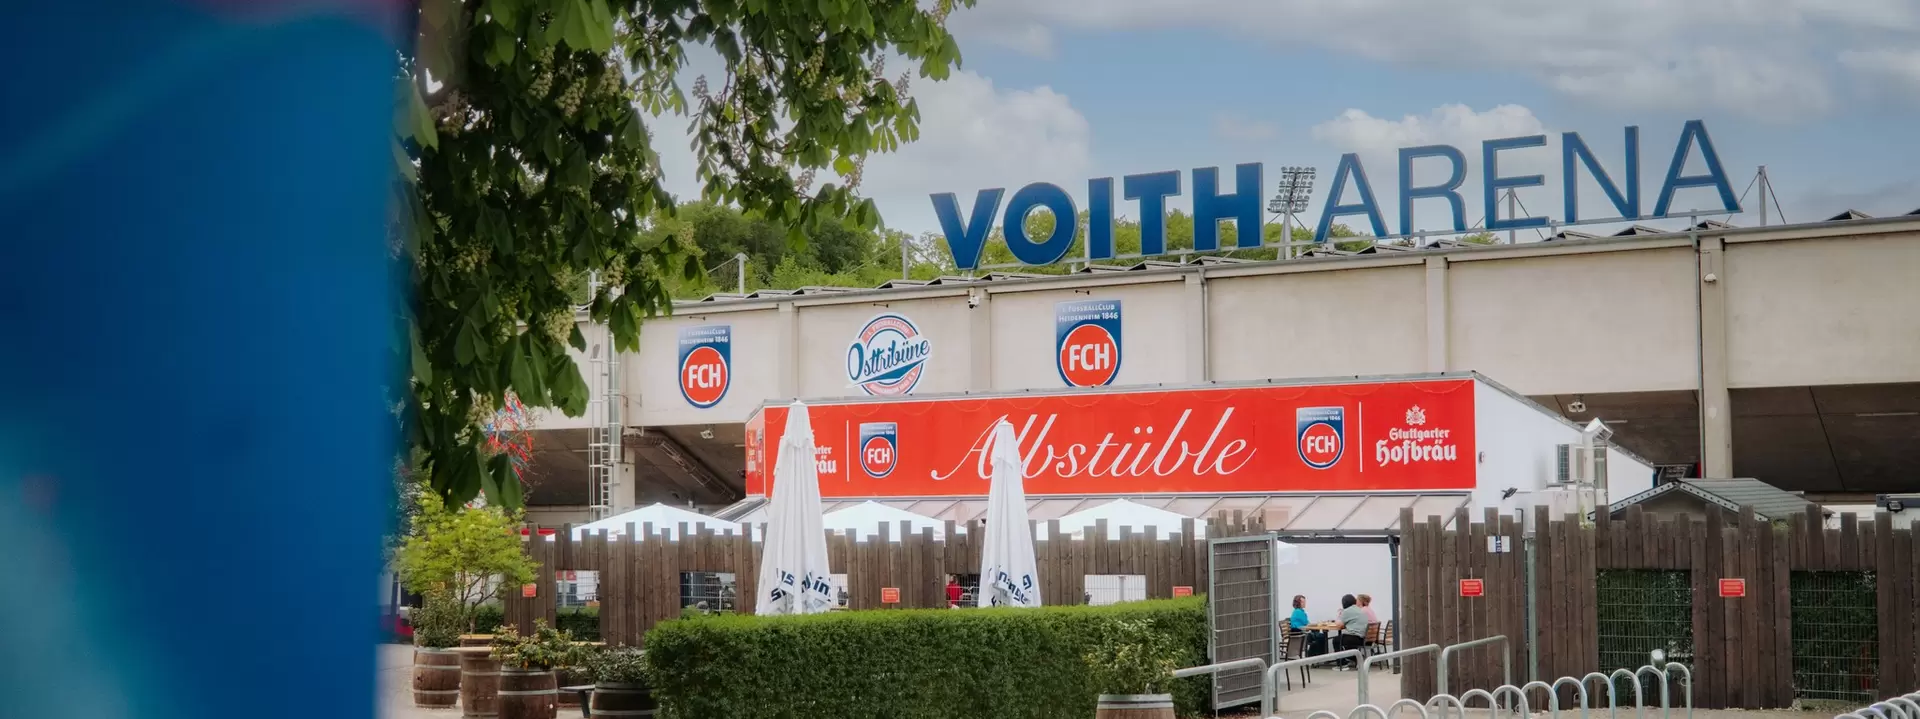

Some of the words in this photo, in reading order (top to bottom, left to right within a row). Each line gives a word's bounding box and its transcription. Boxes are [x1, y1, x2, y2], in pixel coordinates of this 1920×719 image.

[929, 162, 1264, 270] VOITH
[1313, 119, 1743, 243] ARENA
[1102, 312, 1119, 320] 1846
[847, 340, 930, 380] Osttribüne
[1068, 343, 1110, 371] FCH
[688, 363, 721, 388] FCH
[931, 406, 1257, 481] Albstüble
[1306, 435, 1335, 453] FCH
[1389, 427, 1450, 441] Stuttgarter
[867, 447, 890, 464] FCH
[1375, 439, 1457, 467] Hofbräu
